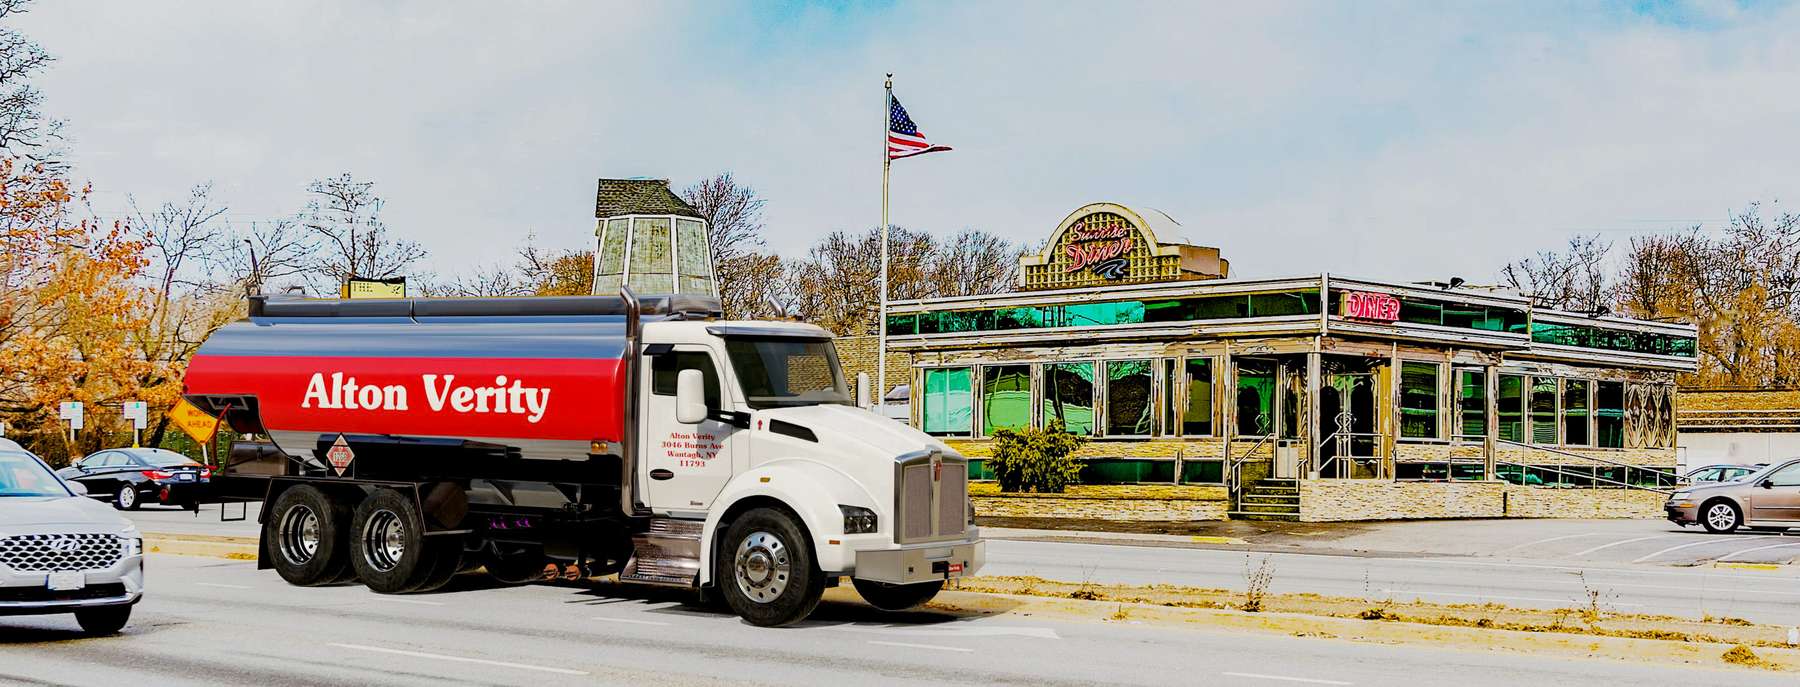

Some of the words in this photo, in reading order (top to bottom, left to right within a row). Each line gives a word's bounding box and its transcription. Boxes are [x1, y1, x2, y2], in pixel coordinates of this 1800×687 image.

[1070, 221, 1125, 242] Sunrise
[1065, 237, 1133, 273] Diner
[1347, 292, 1401, 321] DINER
[301, 371, 408, 411] Alton
[422, 374, 551, 424] Verity
[661, 441, 682, 449] 3046
[670, 432, 690, 440] Alton
[692, 432, 716, 441] Verity
[706, 451, 717, 459] NY
